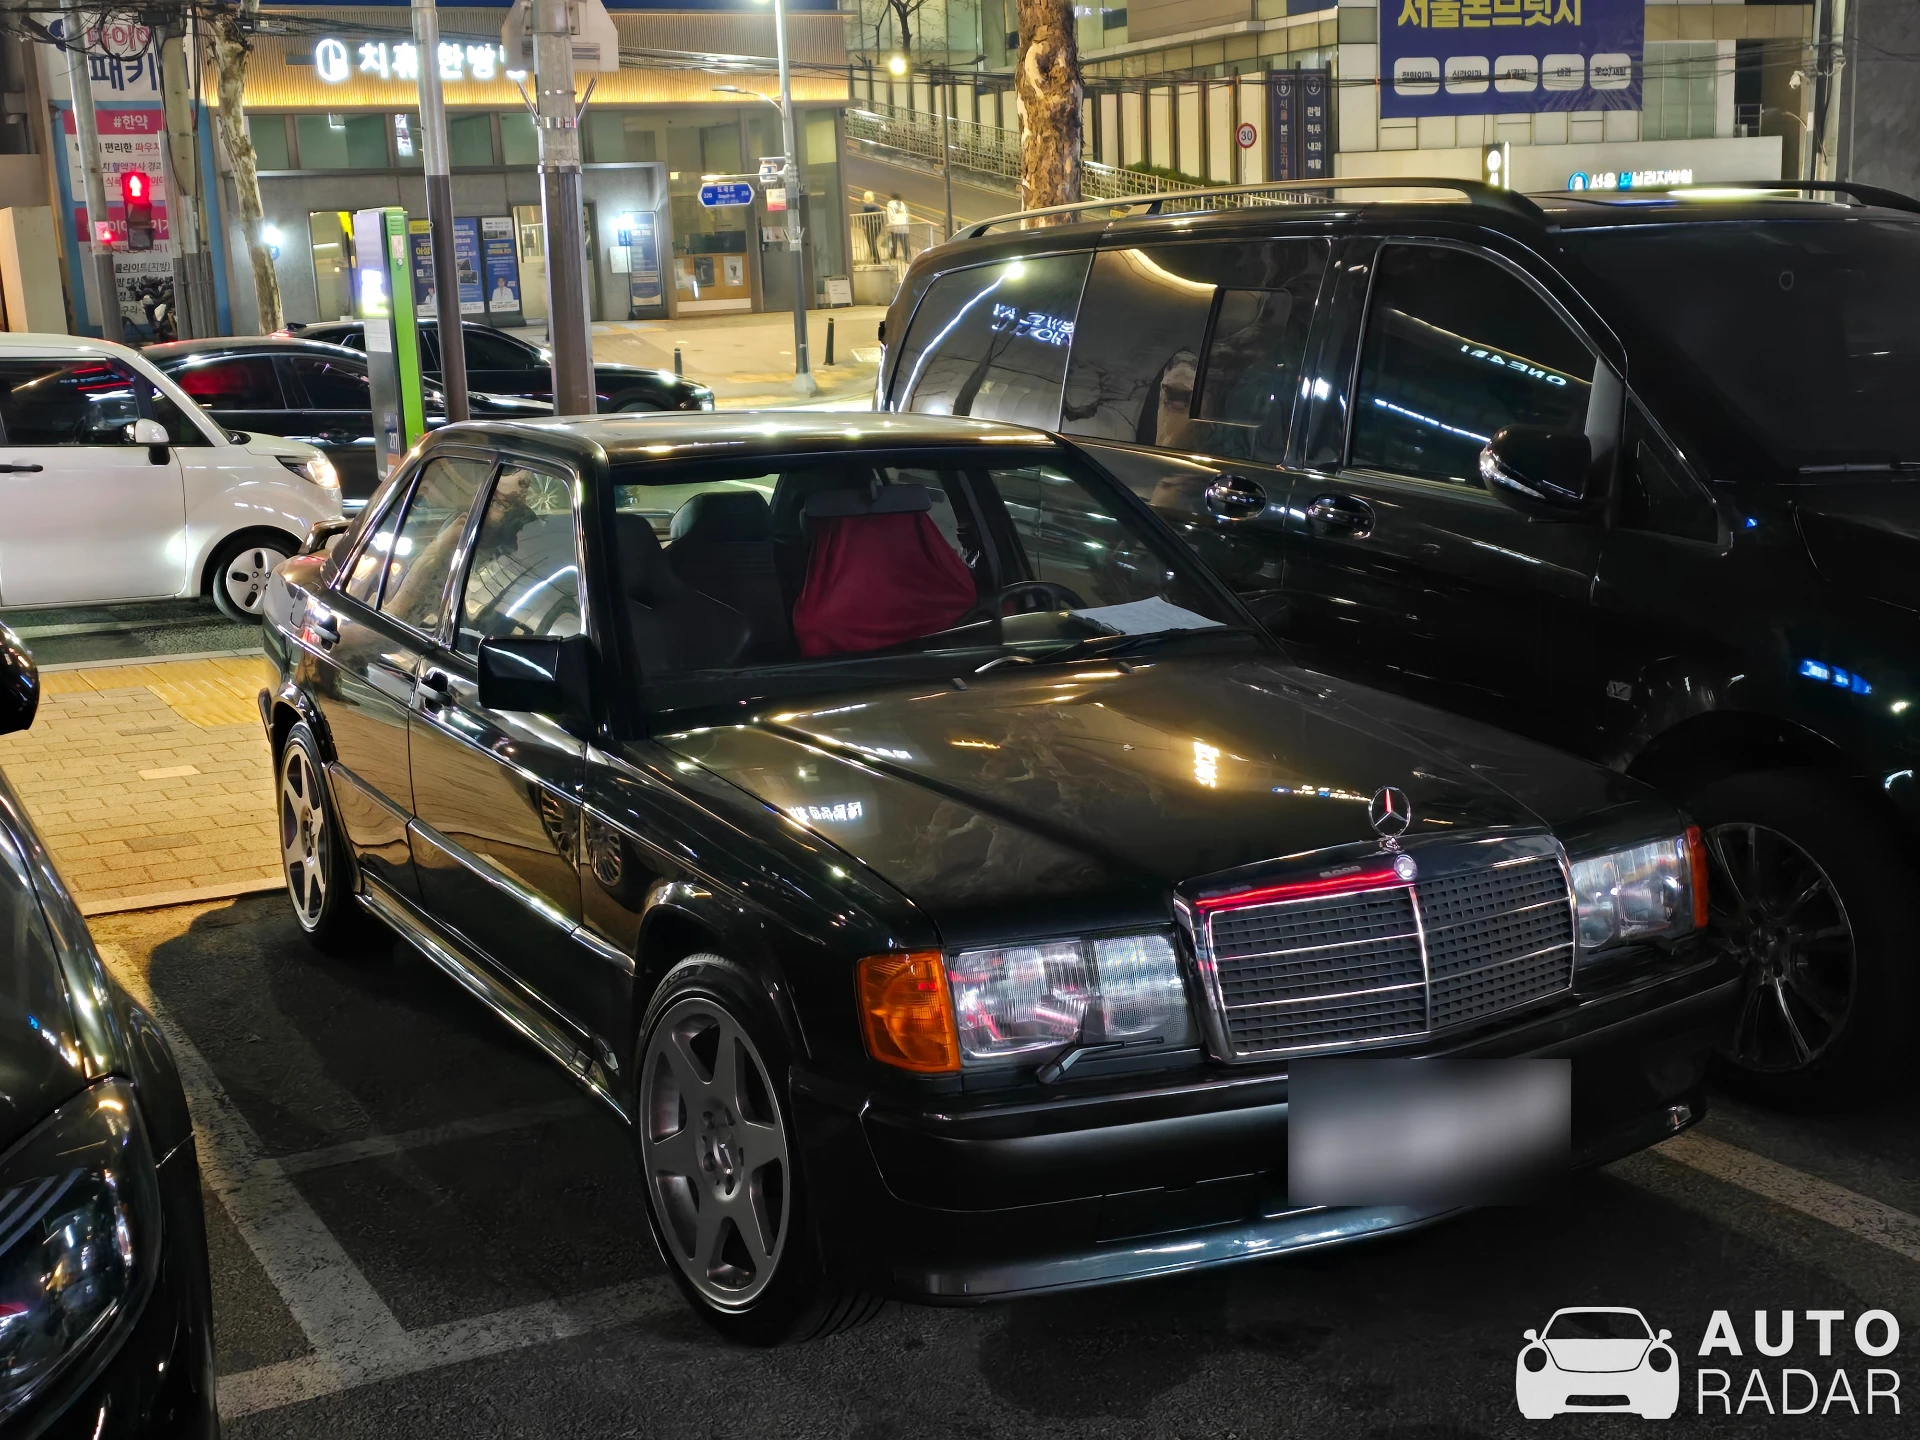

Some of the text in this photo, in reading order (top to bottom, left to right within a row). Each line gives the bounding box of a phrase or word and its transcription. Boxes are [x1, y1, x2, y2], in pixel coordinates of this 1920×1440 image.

[113, 115, 148, 130] #한약
[1240, 130, 1253, 141] 30
[105, 142, 132, 153] 편리한
[1307, 142, 1322, 151] 내과
